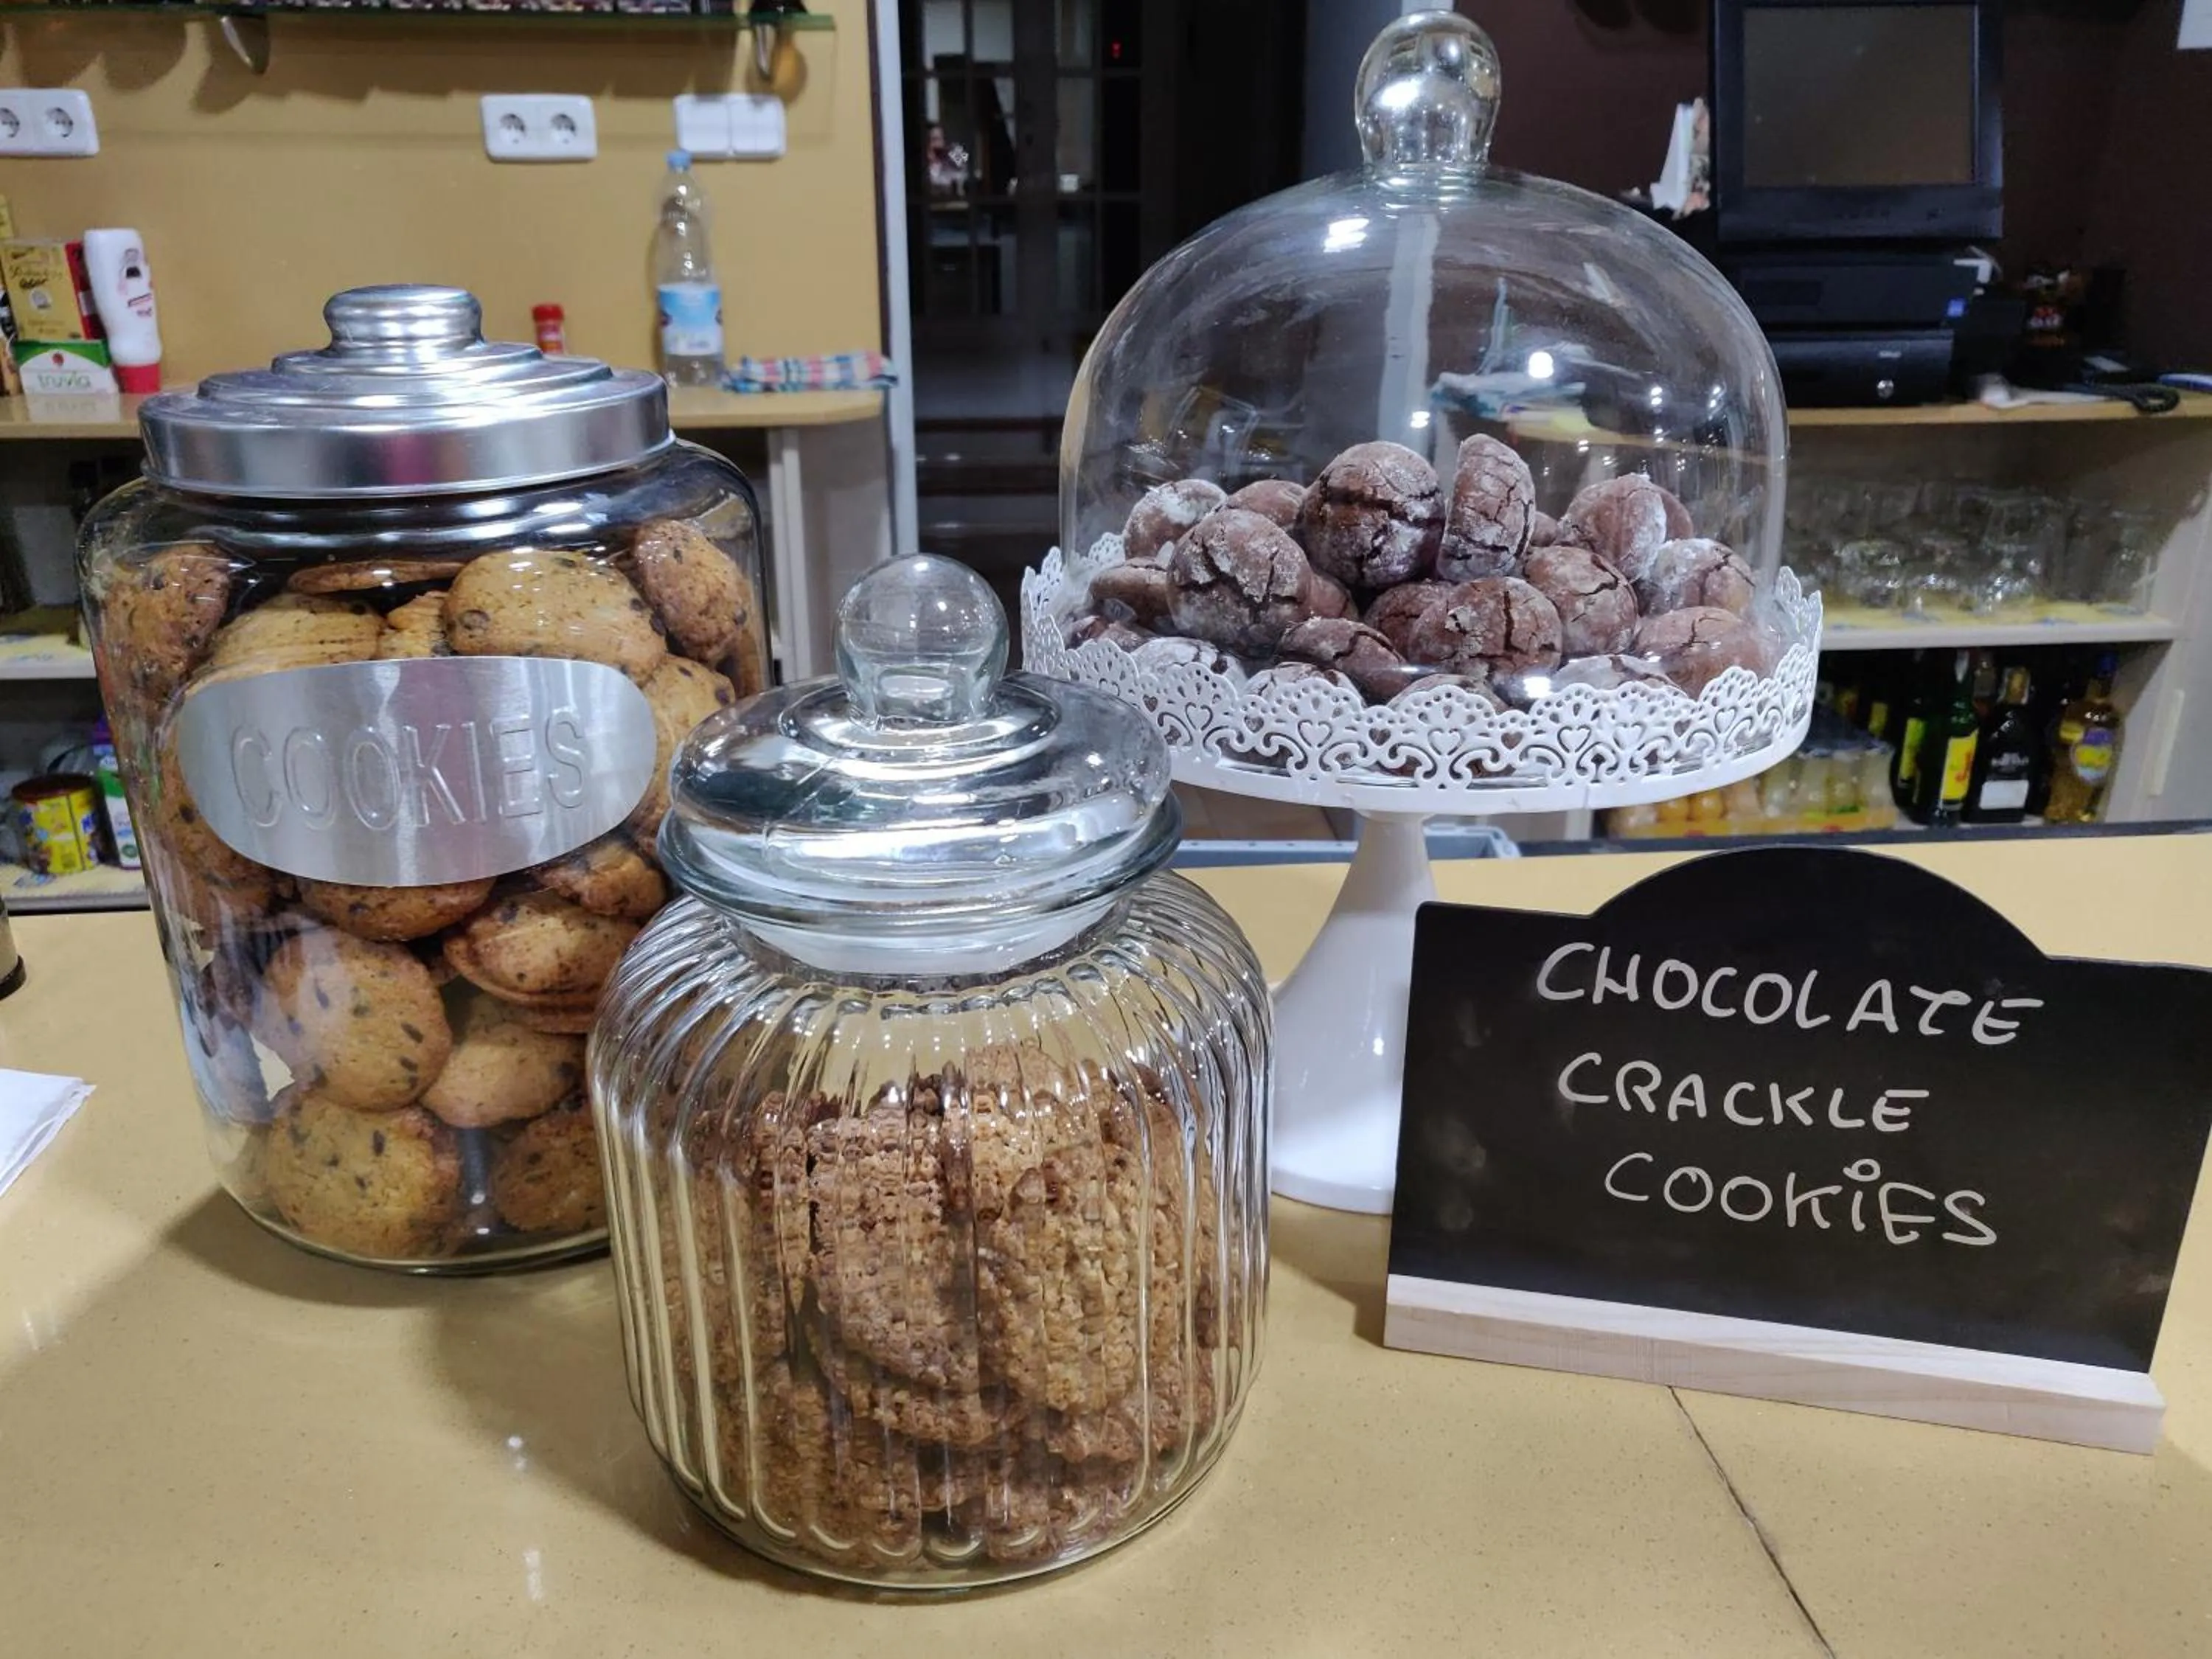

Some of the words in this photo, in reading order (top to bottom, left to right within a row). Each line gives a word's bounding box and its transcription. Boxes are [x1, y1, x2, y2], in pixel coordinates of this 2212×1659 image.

[230, 708, 587, 831] COOKIES
[1535, 942, 2044, 1046] CHOCOLATE
[1557, 1051, 1930, 1133] CRACKLE
